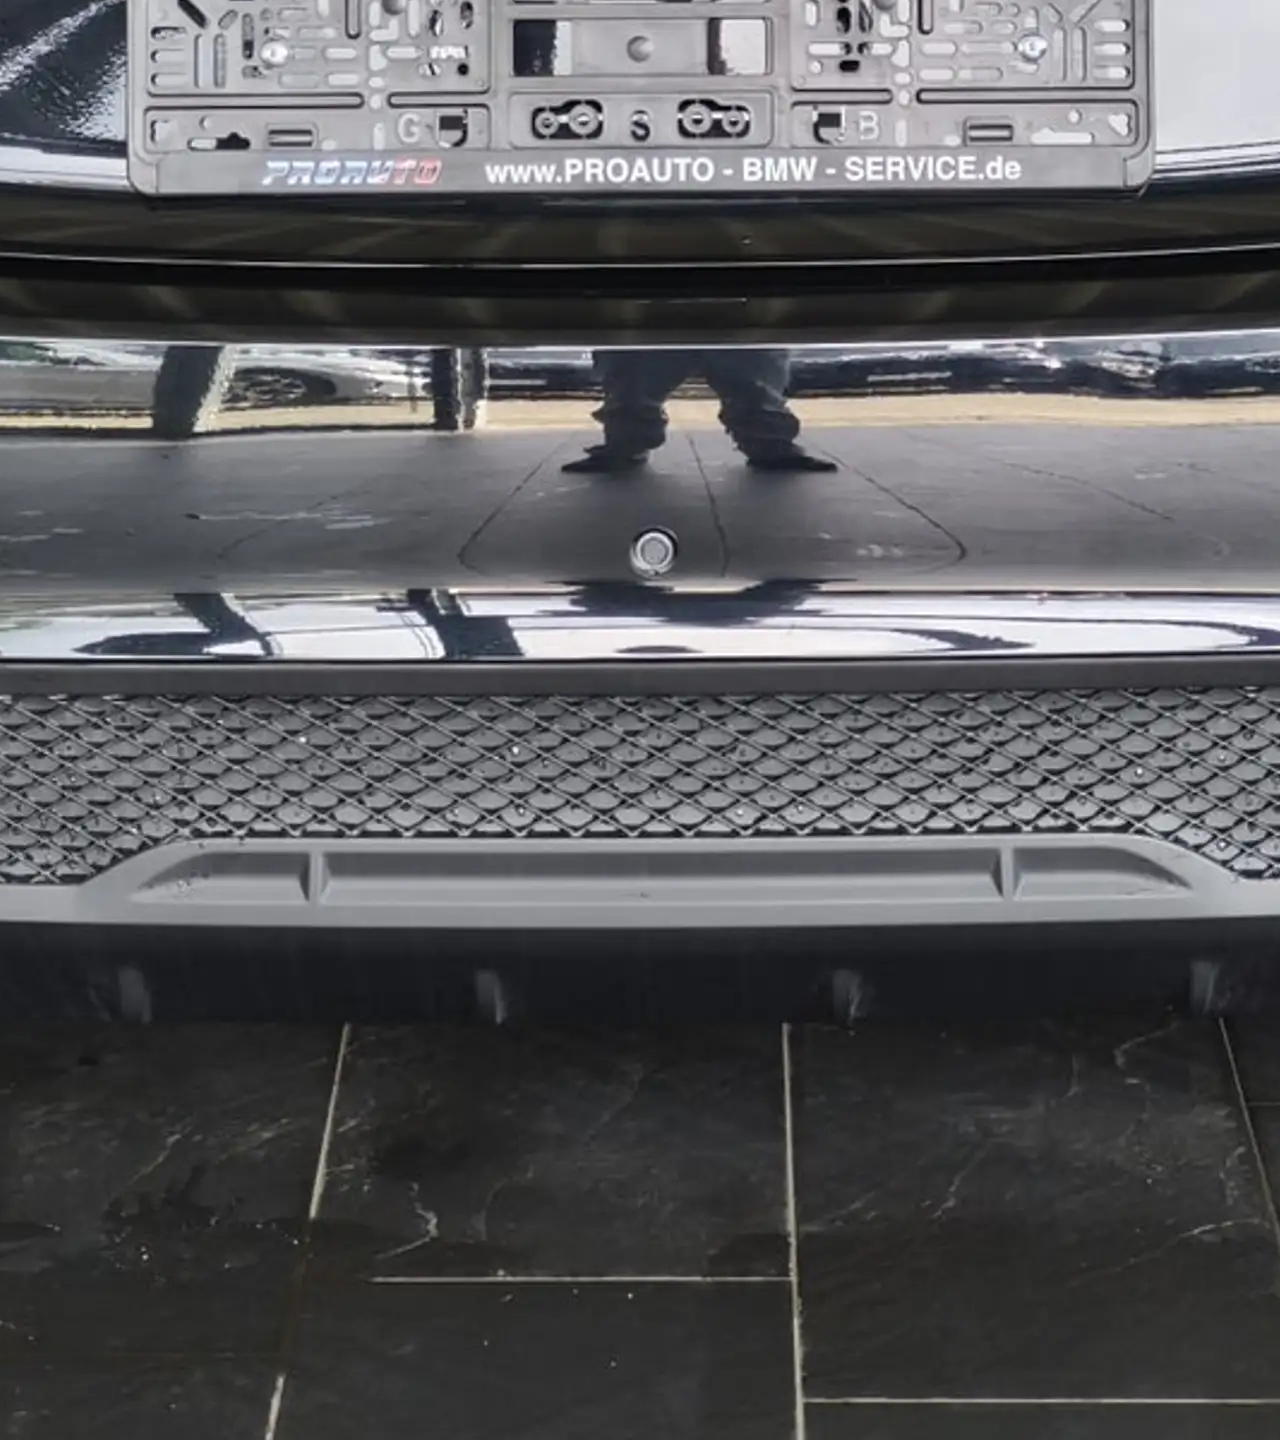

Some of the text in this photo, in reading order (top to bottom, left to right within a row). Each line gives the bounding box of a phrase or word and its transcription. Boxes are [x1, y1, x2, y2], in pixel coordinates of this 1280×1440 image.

[261, 159, 443, 186] PROAUTO
[485, 156, 716, 184] www.PROAUTO
[742, 155, 818, 182] BMW
[844, 154, 1022, 182] SERVICE.de
